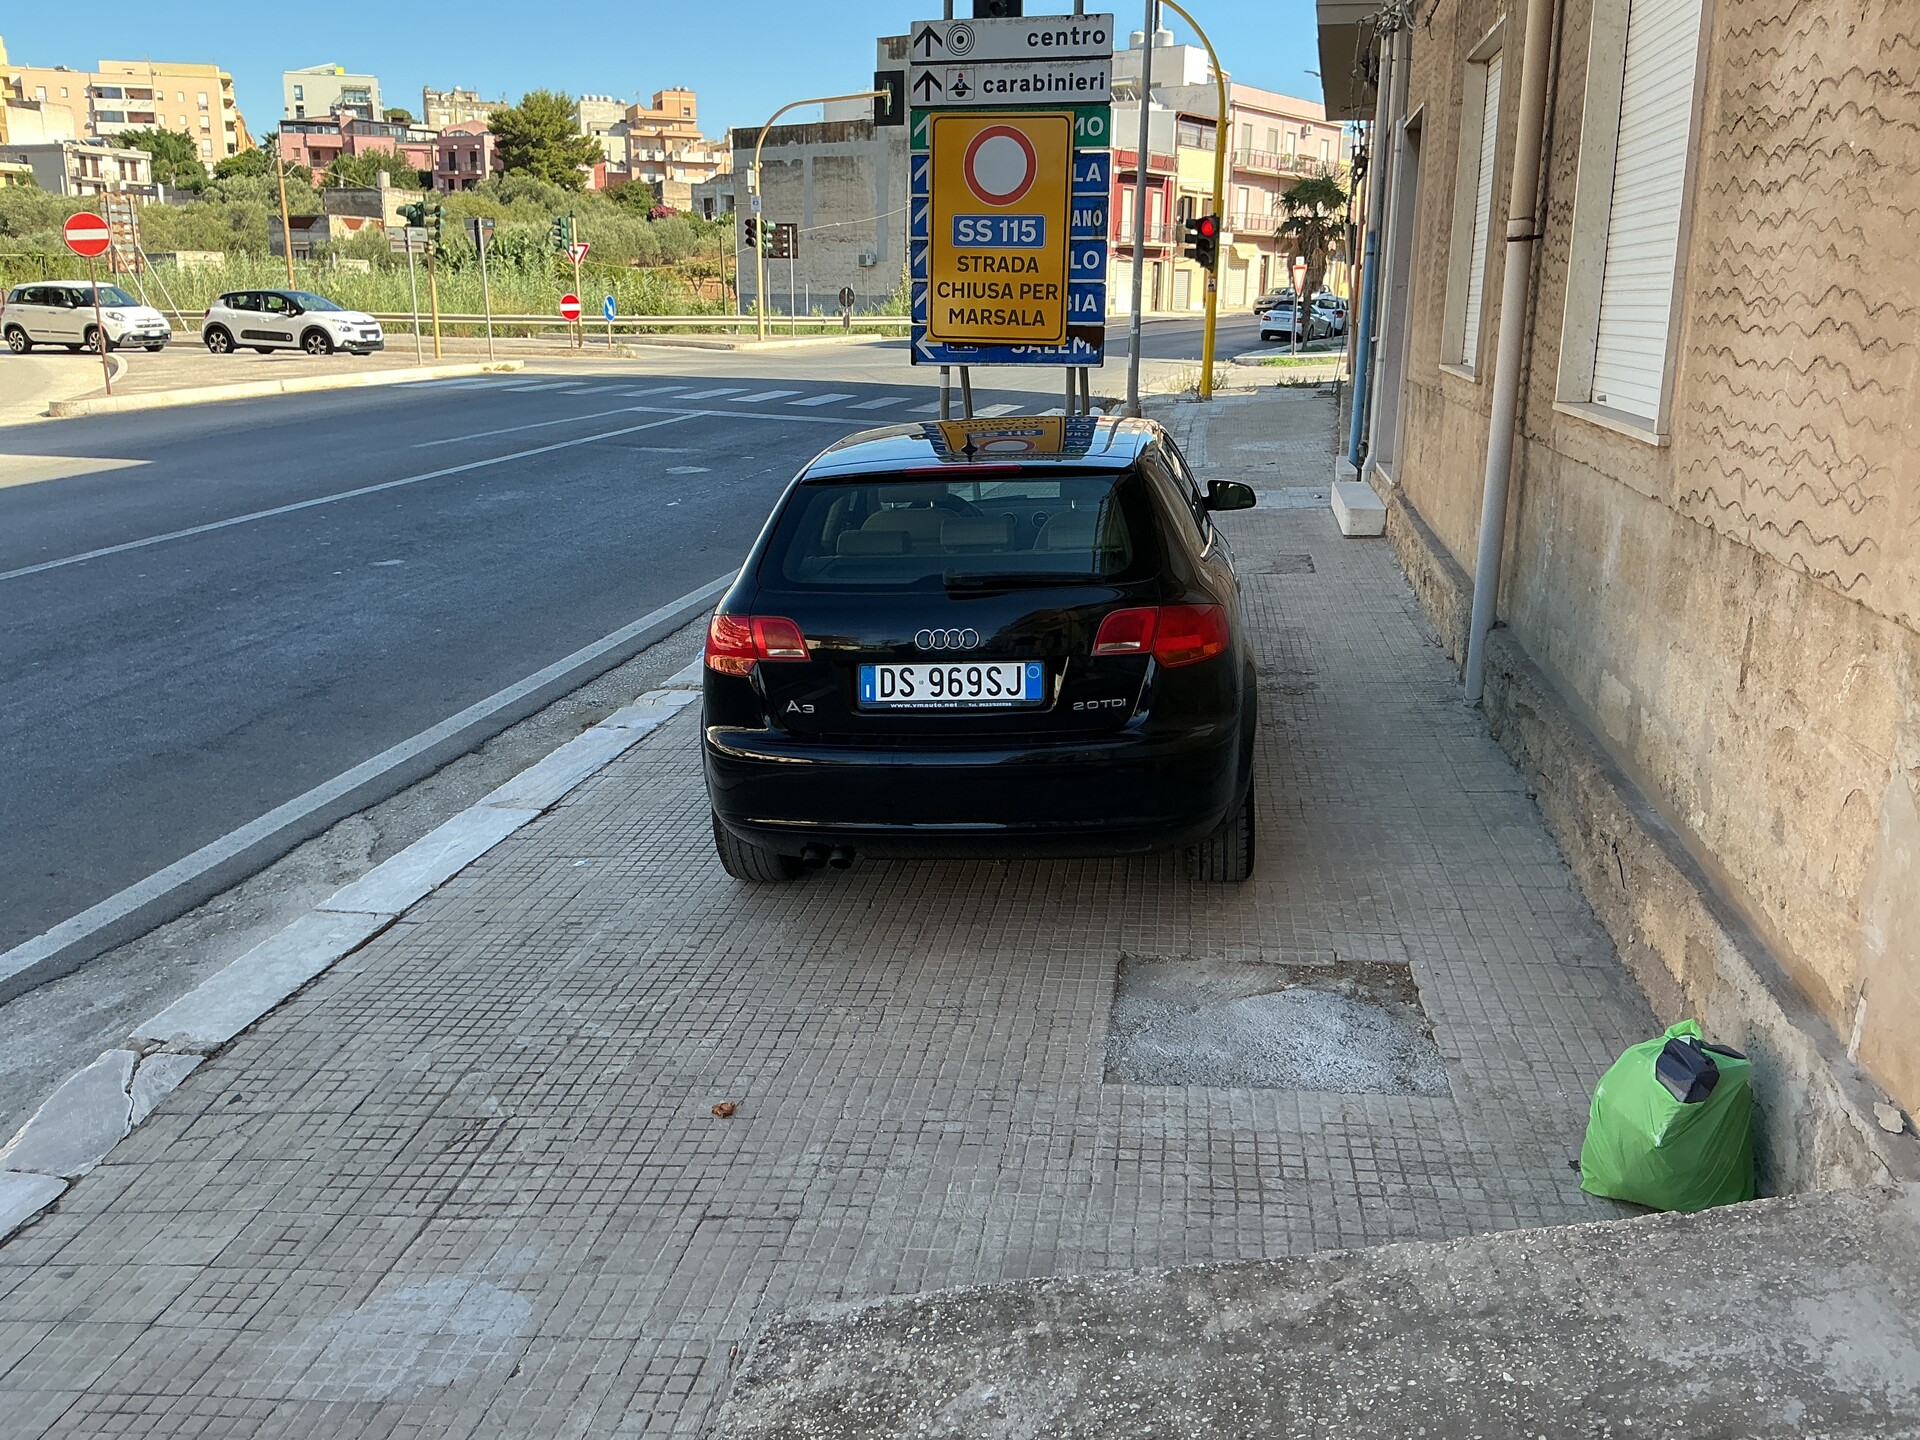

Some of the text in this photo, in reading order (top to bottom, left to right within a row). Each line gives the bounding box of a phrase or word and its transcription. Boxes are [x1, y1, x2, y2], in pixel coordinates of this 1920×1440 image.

[1027, 26, 1106, 47] centro
[983, 71, 1105, 93] carabinieri
[958, 219, 1037, 243] SS 115
[957, 255, 1040, 273] STRADA
[936, 281, 1059, 301] CHIUSA PER
[949, 308, 1046, 327] MARSALA
[1011, 336, 1098, 355] SALEM
[880, 667, 915, 698] DS
[928, 665, 1022, 698] 969SJ
[786, 700, 815, 713] A3
